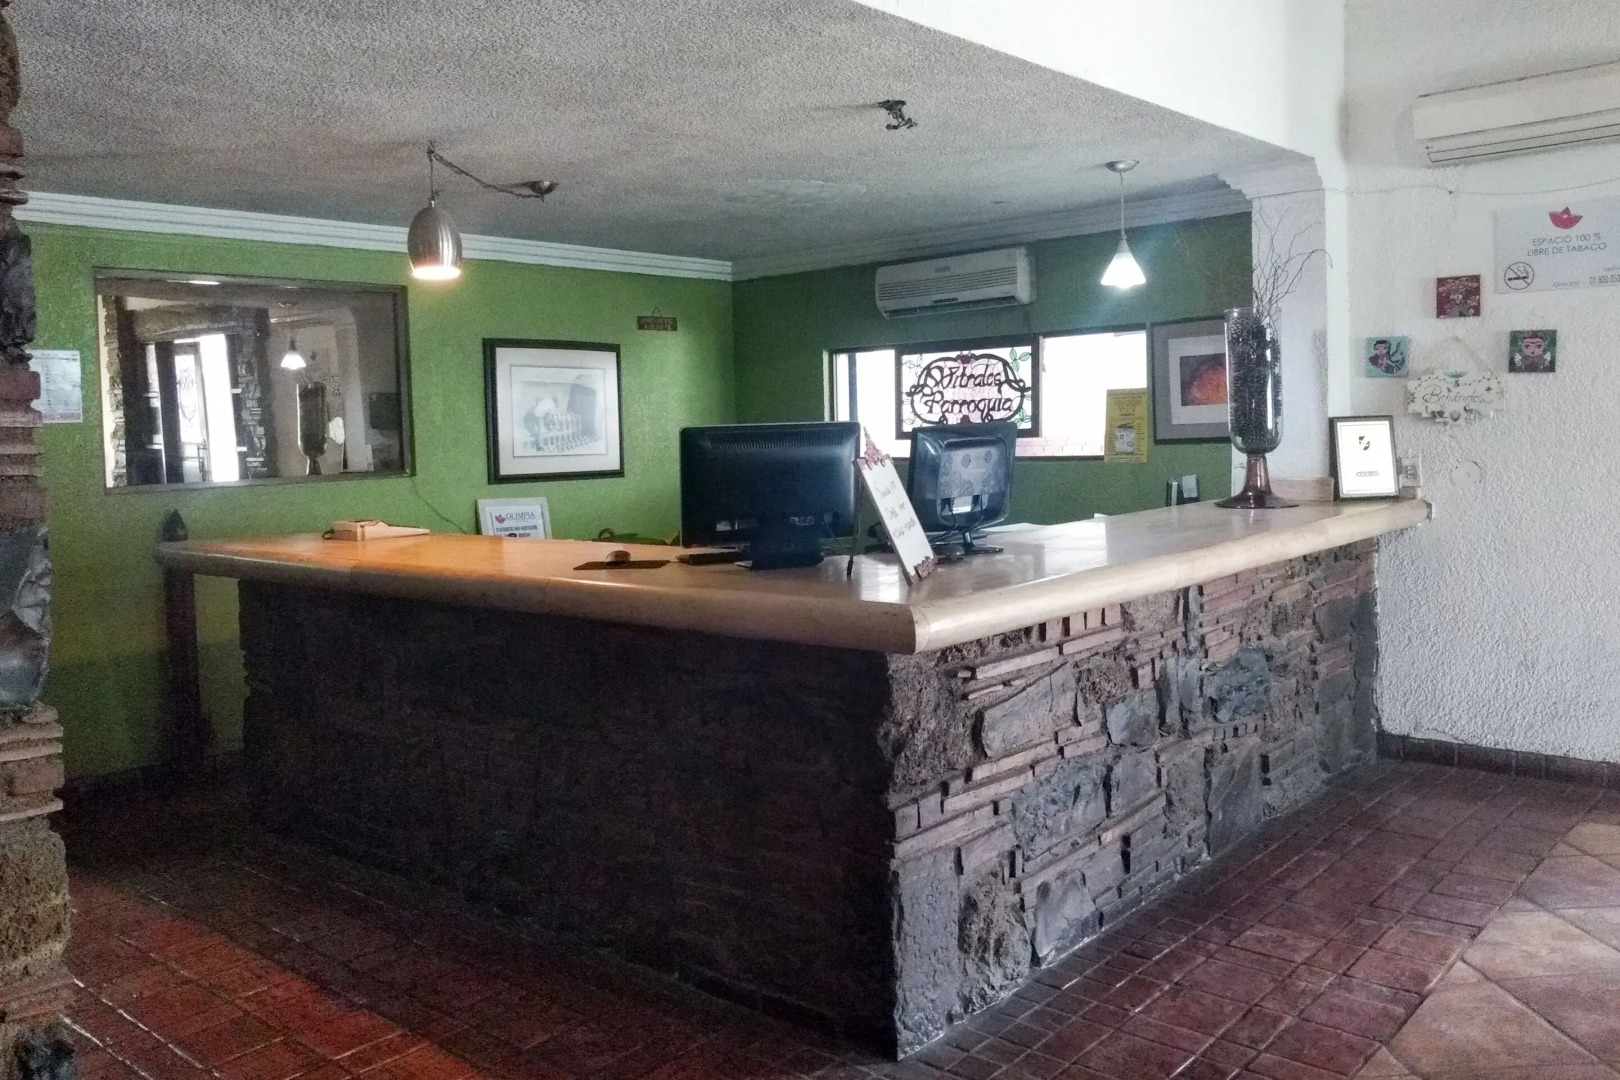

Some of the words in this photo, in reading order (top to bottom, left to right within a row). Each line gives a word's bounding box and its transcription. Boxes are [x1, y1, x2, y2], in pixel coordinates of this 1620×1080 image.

[1532, 235, 1572, 247] ESPACIO
[1575, 233, 1591, 242] 100
[1527, 248, 1549, 257] LIBRE
[1552, 246, 1564, 255] DE
[1567, 242, 1607, 252] TABACO
[926, 364, 1003, 395] Vitrales
[921, 391, 1013, 422] Parroquia
[505, 512, 536, 520] OLIMPIA
